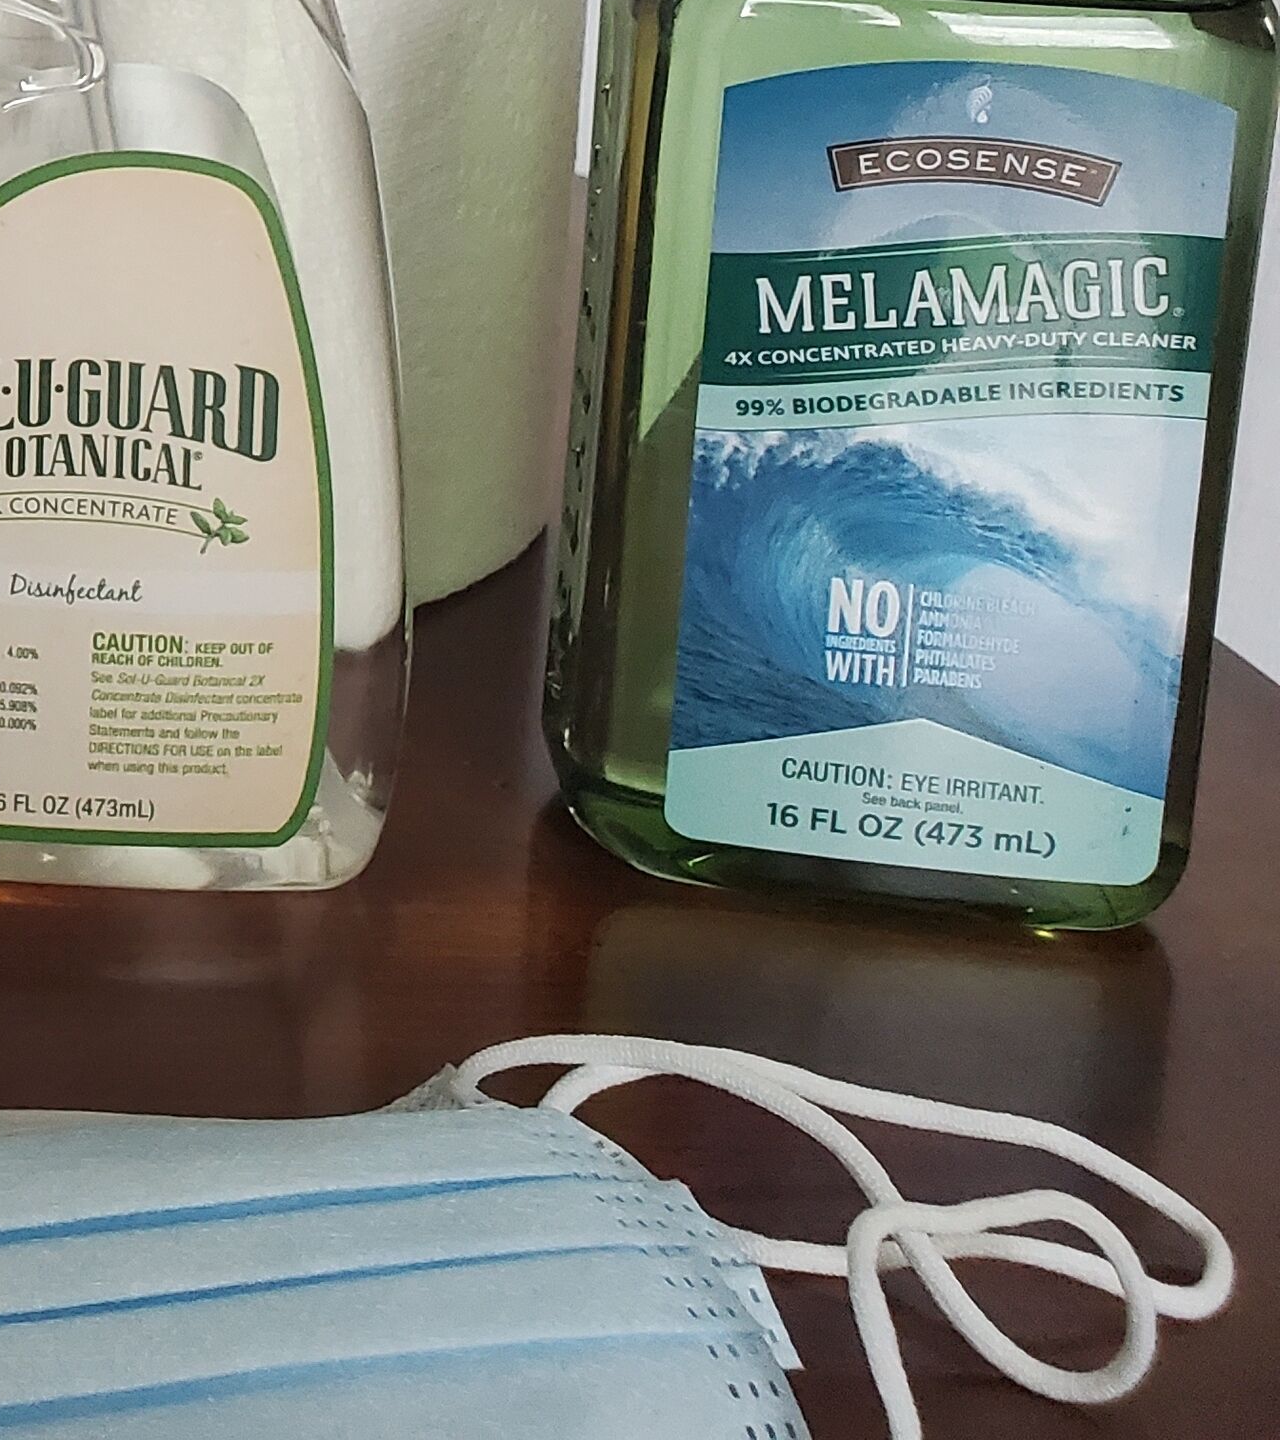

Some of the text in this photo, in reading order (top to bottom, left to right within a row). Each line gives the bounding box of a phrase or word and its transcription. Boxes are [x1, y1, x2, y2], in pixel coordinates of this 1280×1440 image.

[858, 150, 1085, 187] ECOSENSE
[724, 331, 1197, 367] 4X CONCENTRATED HEAVY-DUTY CLEANER
[735, 382, 1184, 417] 99% BIODEGRADABLE INGREDIENTS
[9, 496, 178, 526] CONCENTRATE
[10, 573, 143, 606] Disinfectant
[828, 577, 900, 638] NO
[92, 631, 274, 655] CAUTION: KEEP OUT OF
[825, 635, 896, 653] INGREDIENTS
[917, 630, 1020, 654] FORMALDEHYDE
[91, 653, 223, 668] REACH OF CHILDREN.
[825, 651, 895, 687] WITH
[915, 649, 996, 671] PHTHALATES
[913, 668, 983, 689] PARABENS
[781, 757, 1044, 805] CAUTION: EYE IRRITANT.
[13, 794, 36, 814] FL
[42, 796, 69, 816] OZ
[75, 796, 155, 821] (473mL)
[861, 792, 964, 815] See back panel.
[766, 802, 1057, 859] 16 FL OZ (473 mL)
